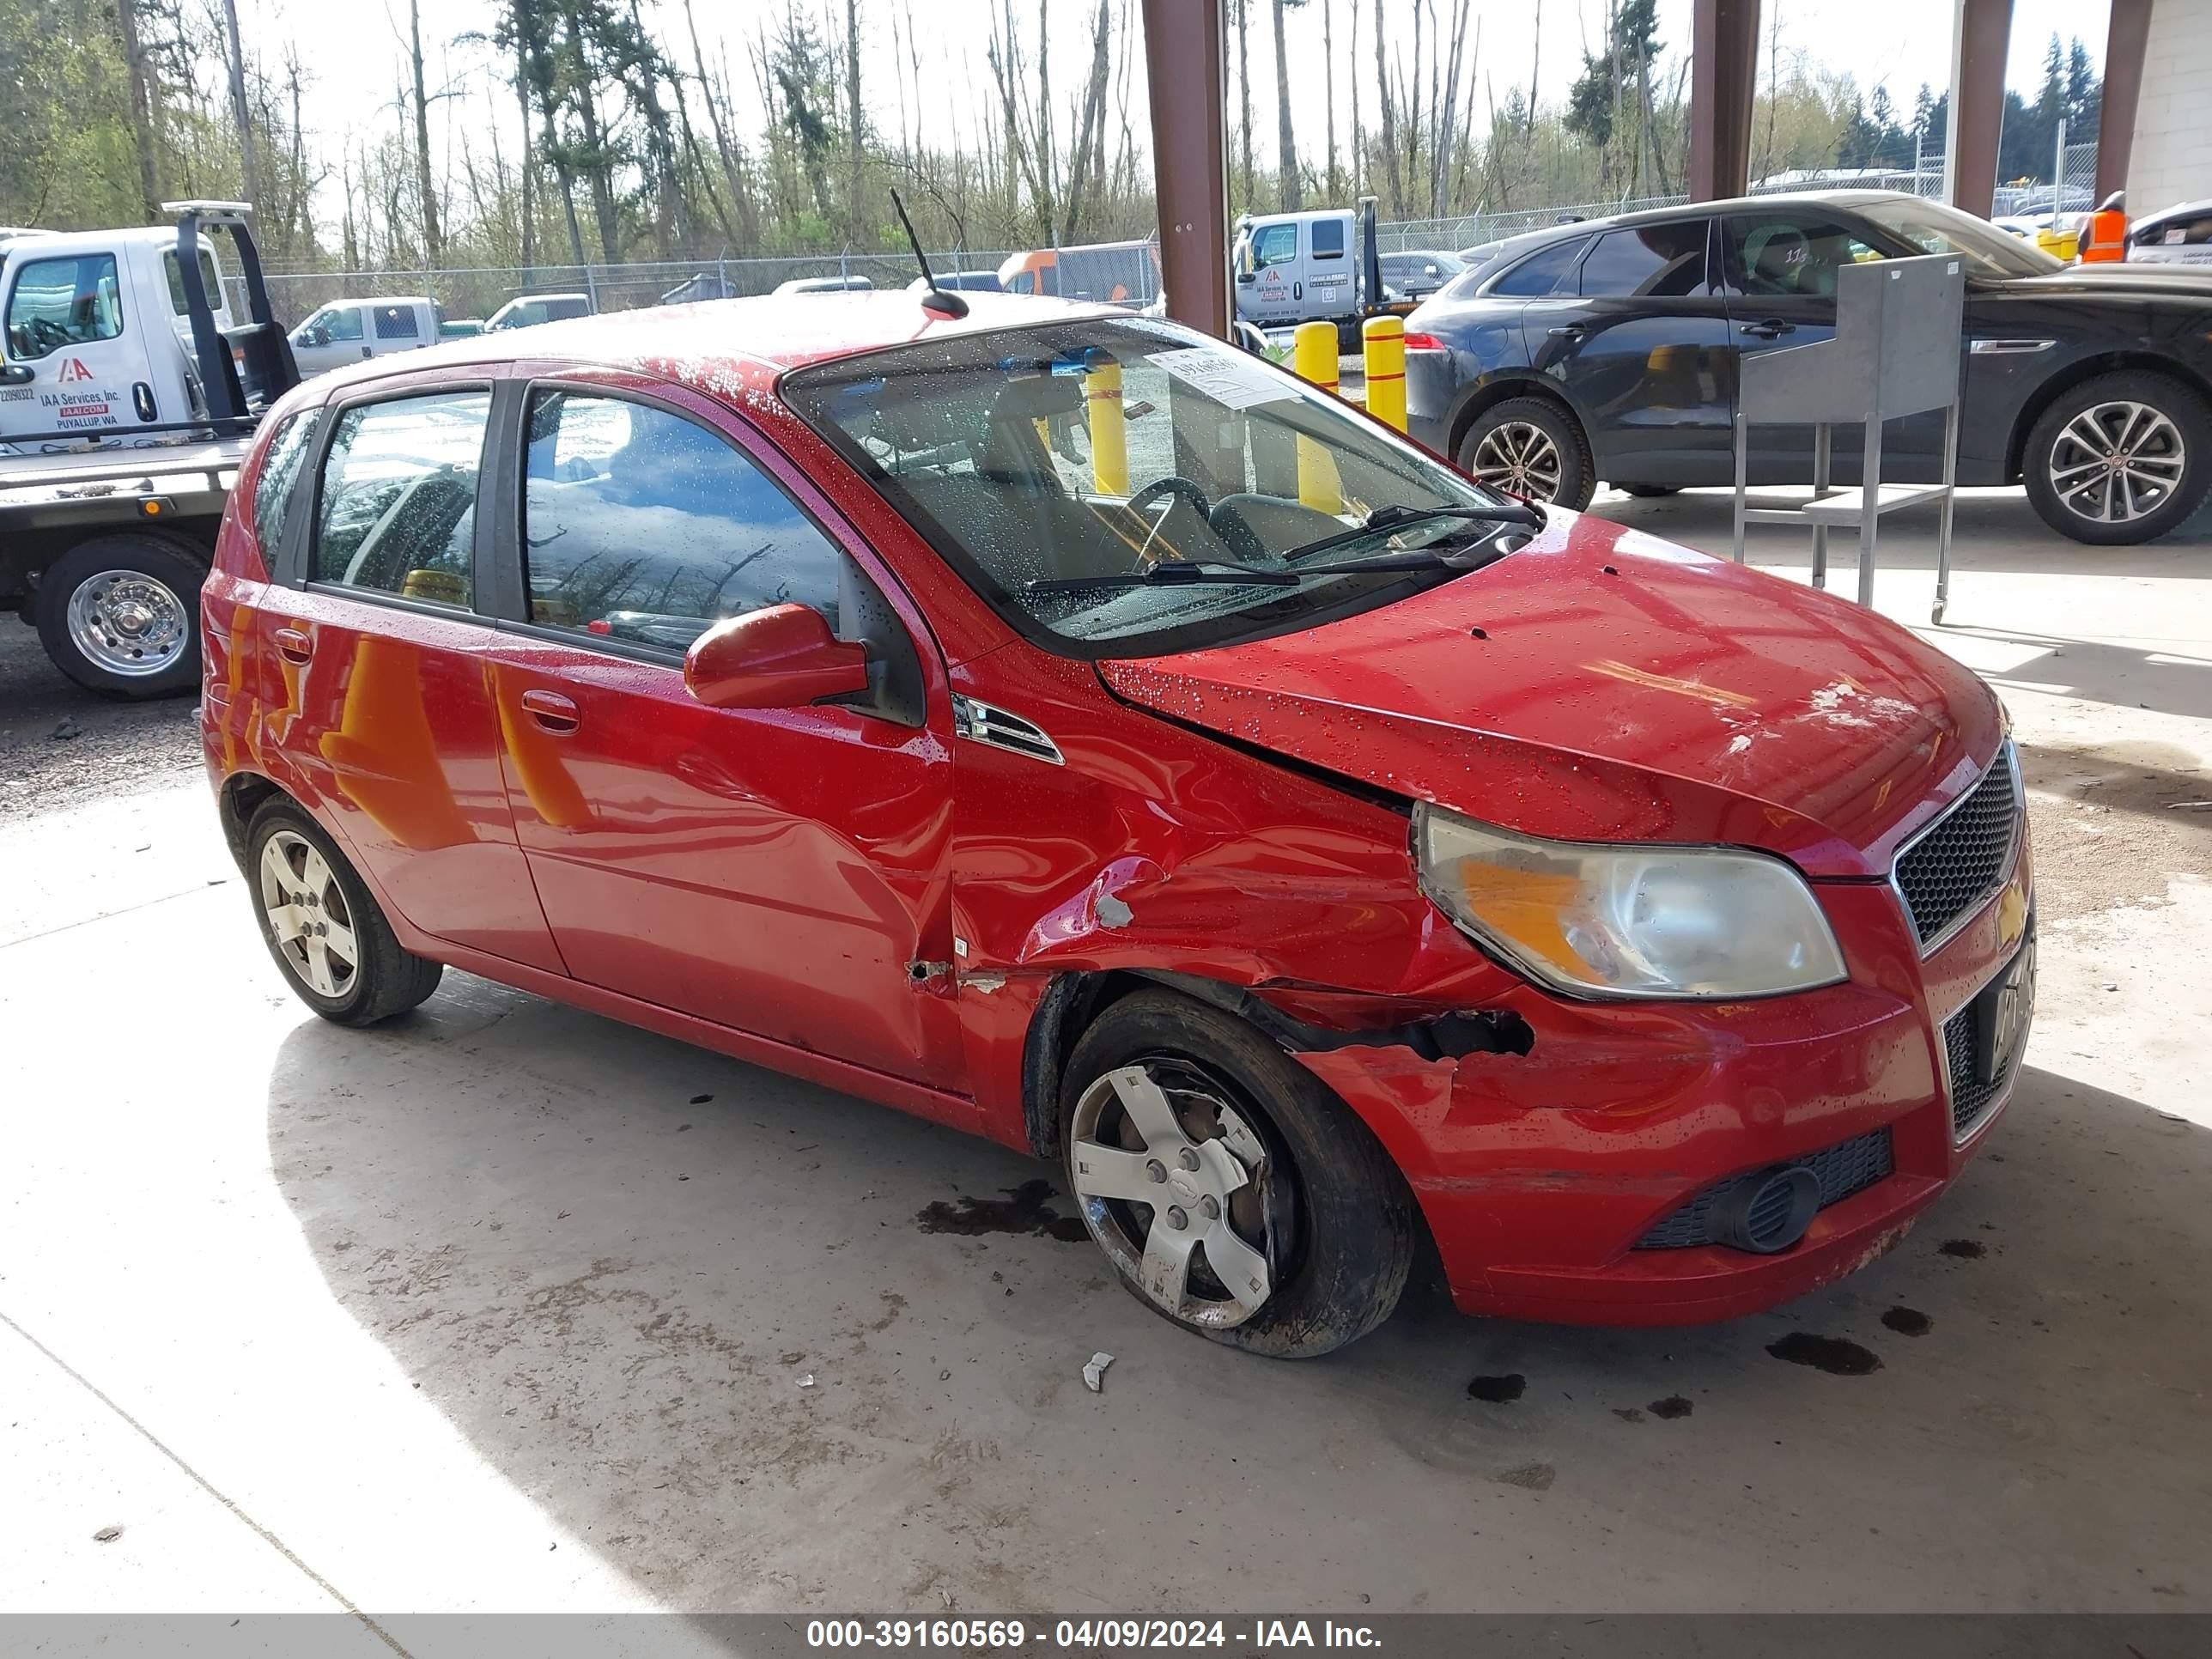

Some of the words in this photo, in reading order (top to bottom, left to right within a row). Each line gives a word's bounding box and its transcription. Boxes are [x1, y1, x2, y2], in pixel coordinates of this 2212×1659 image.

[40, 394, 60, 407] IAA
[104, 389, 121, 401] Inc.
[63, 405, 106, 416] IAAI.COM
[103, 416, 118, 425] WA
